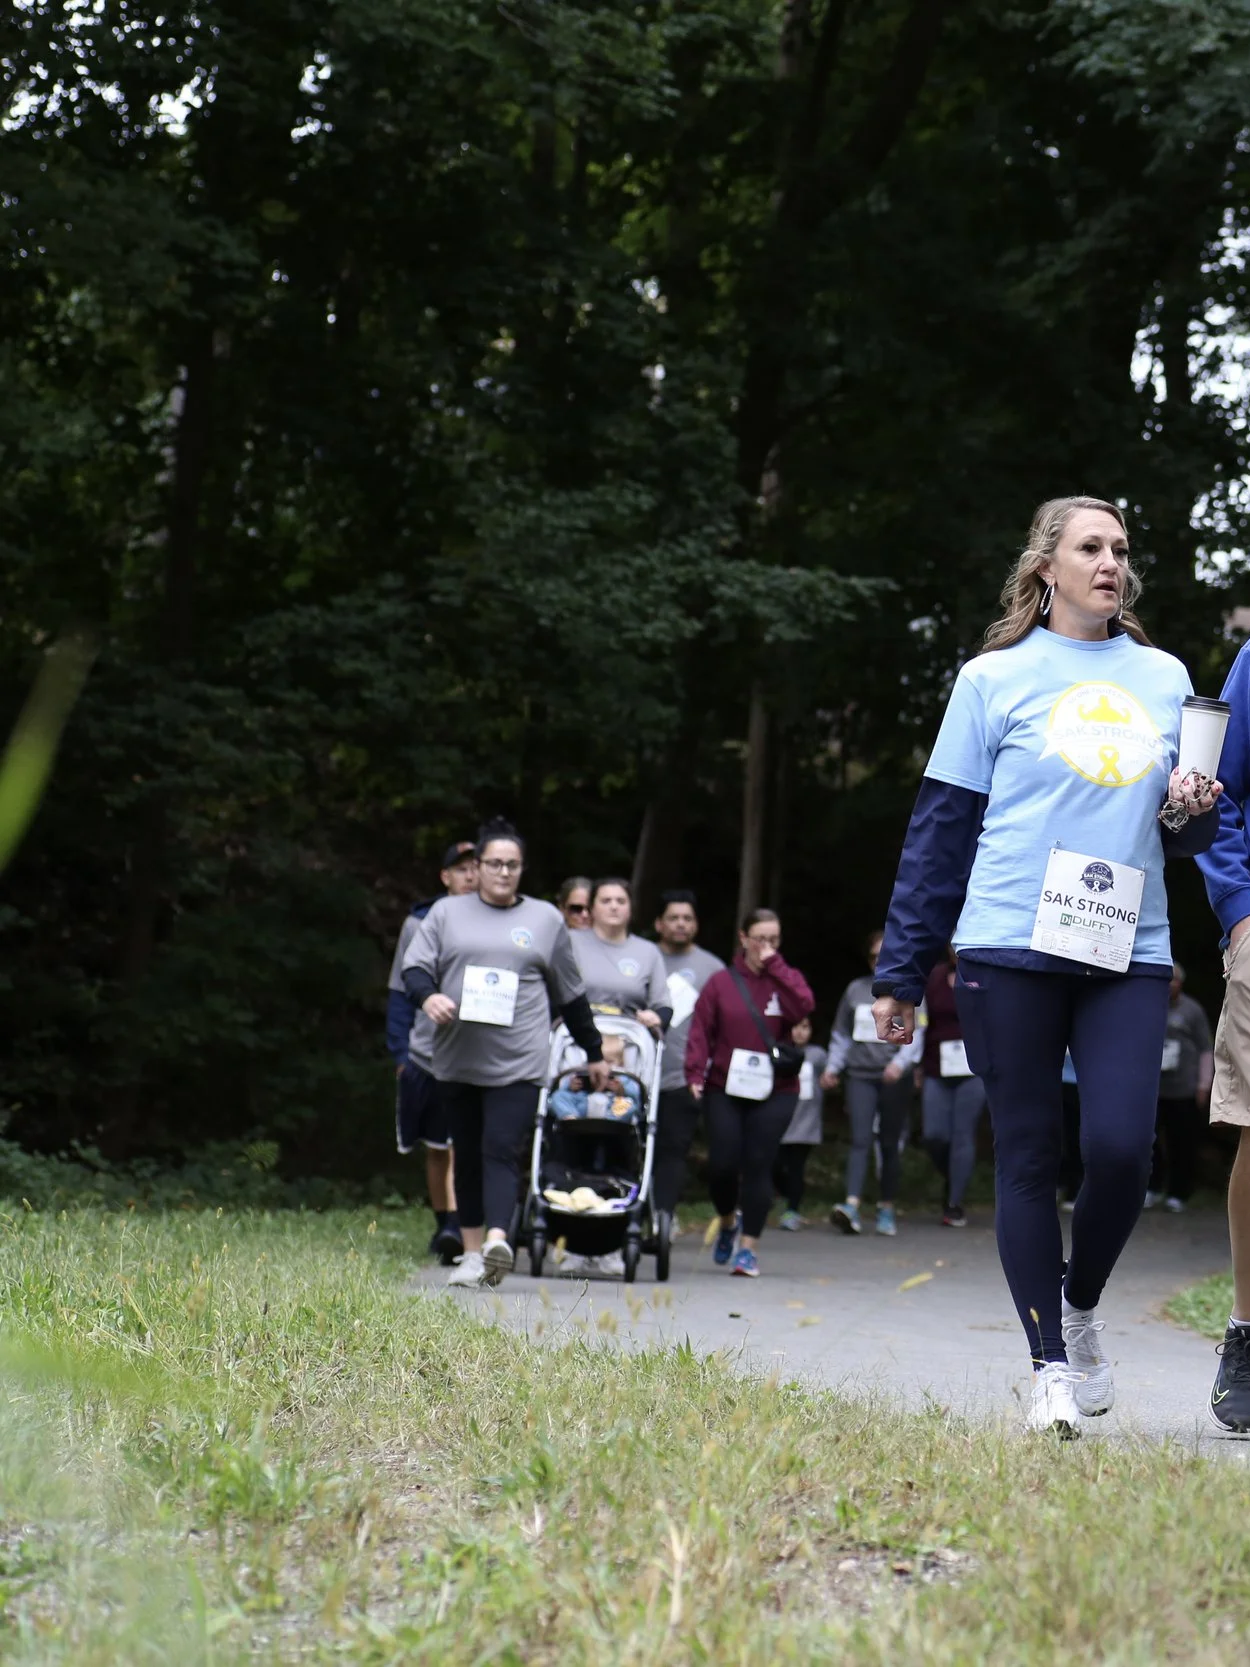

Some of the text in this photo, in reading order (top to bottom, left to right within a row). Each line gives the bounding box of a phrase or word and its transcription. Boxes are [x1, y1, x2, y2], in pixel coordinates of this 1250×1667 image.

[1053, 725, 1157, 749] SAK STRONG
[1043, 890, 1137, 925] SAK STRONG
[1072, 915, 1115, 934] DUFFY
